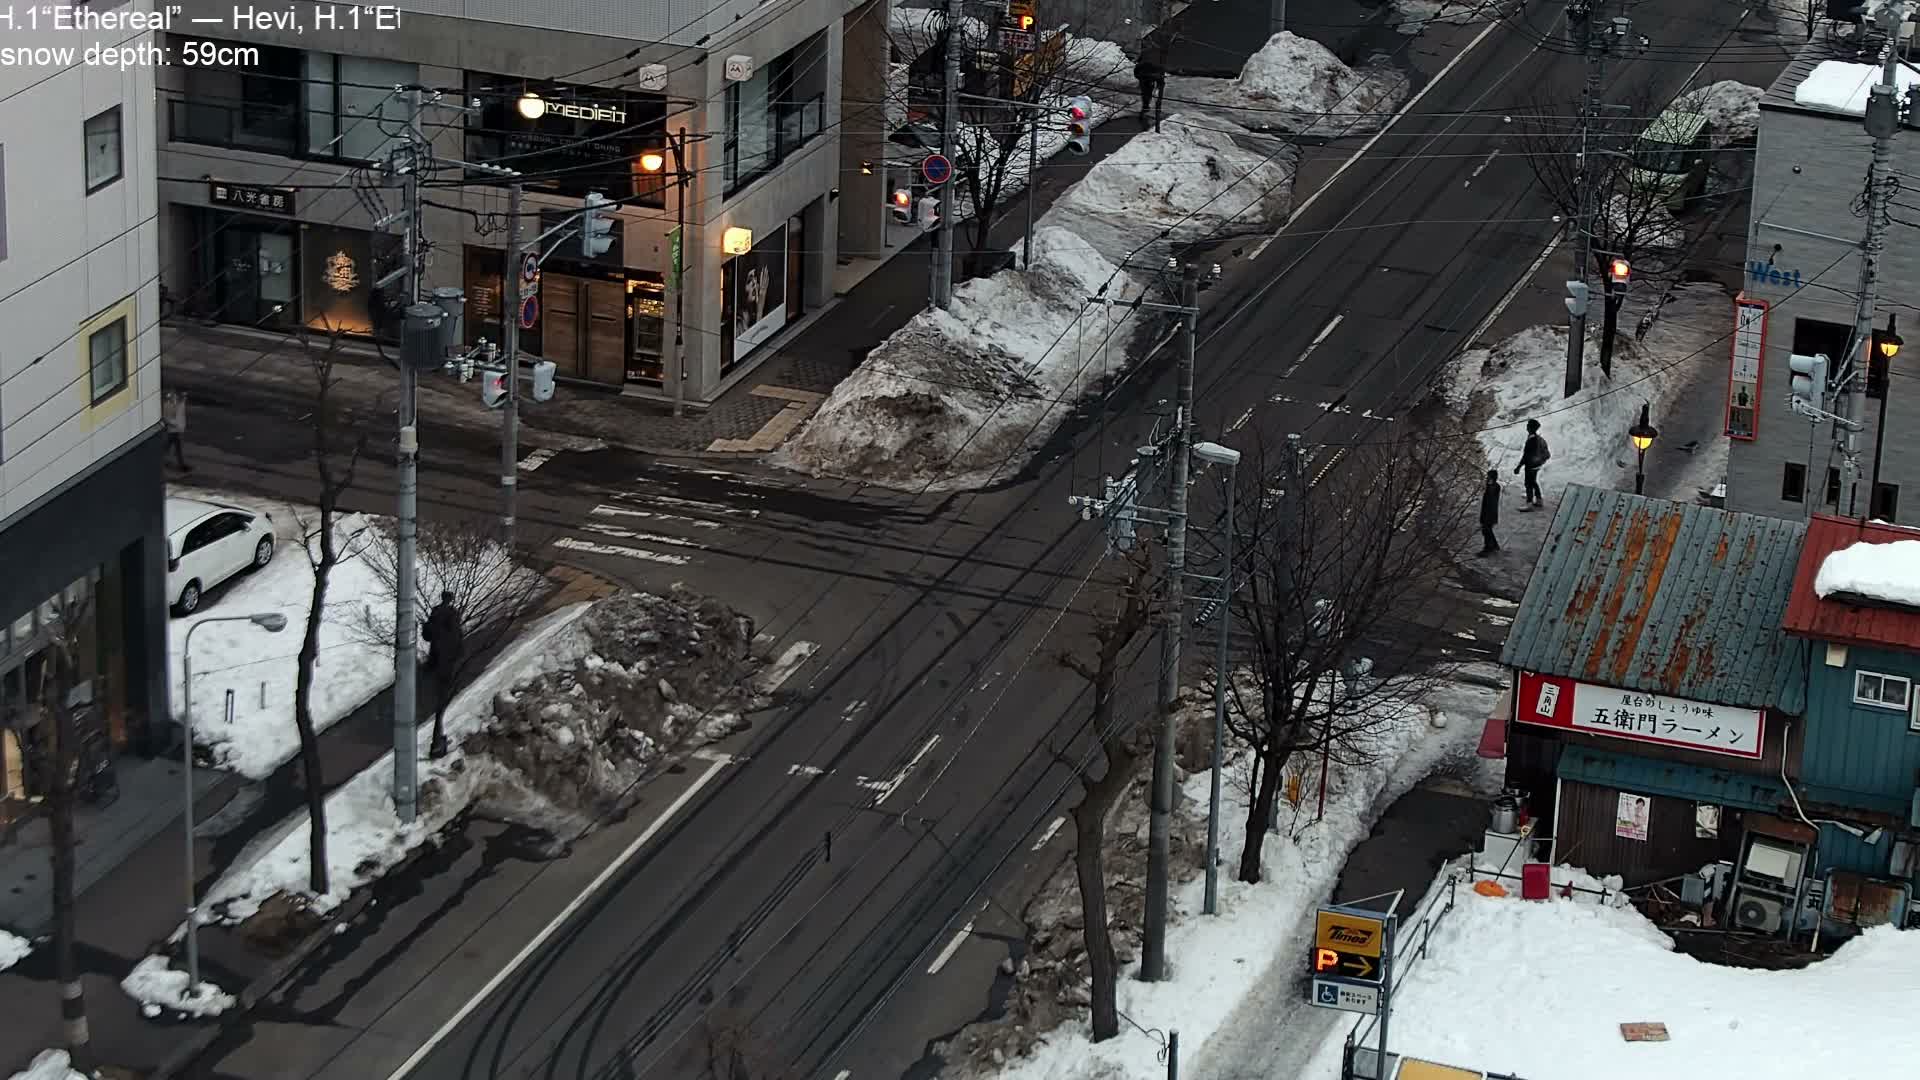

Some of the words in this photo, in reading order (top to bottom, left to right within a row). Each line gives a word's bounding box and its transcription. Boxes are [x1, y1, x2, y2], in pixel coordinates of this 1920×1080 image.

[1750, 261, 1801, 288] West
[1540, 687, 1555, 714] 三角山
[1590, 708, 1745, 744] 五衛門ラーメン
[1328, 925, 1374, 945] Times
[1317, 949, 1339, 971] P
